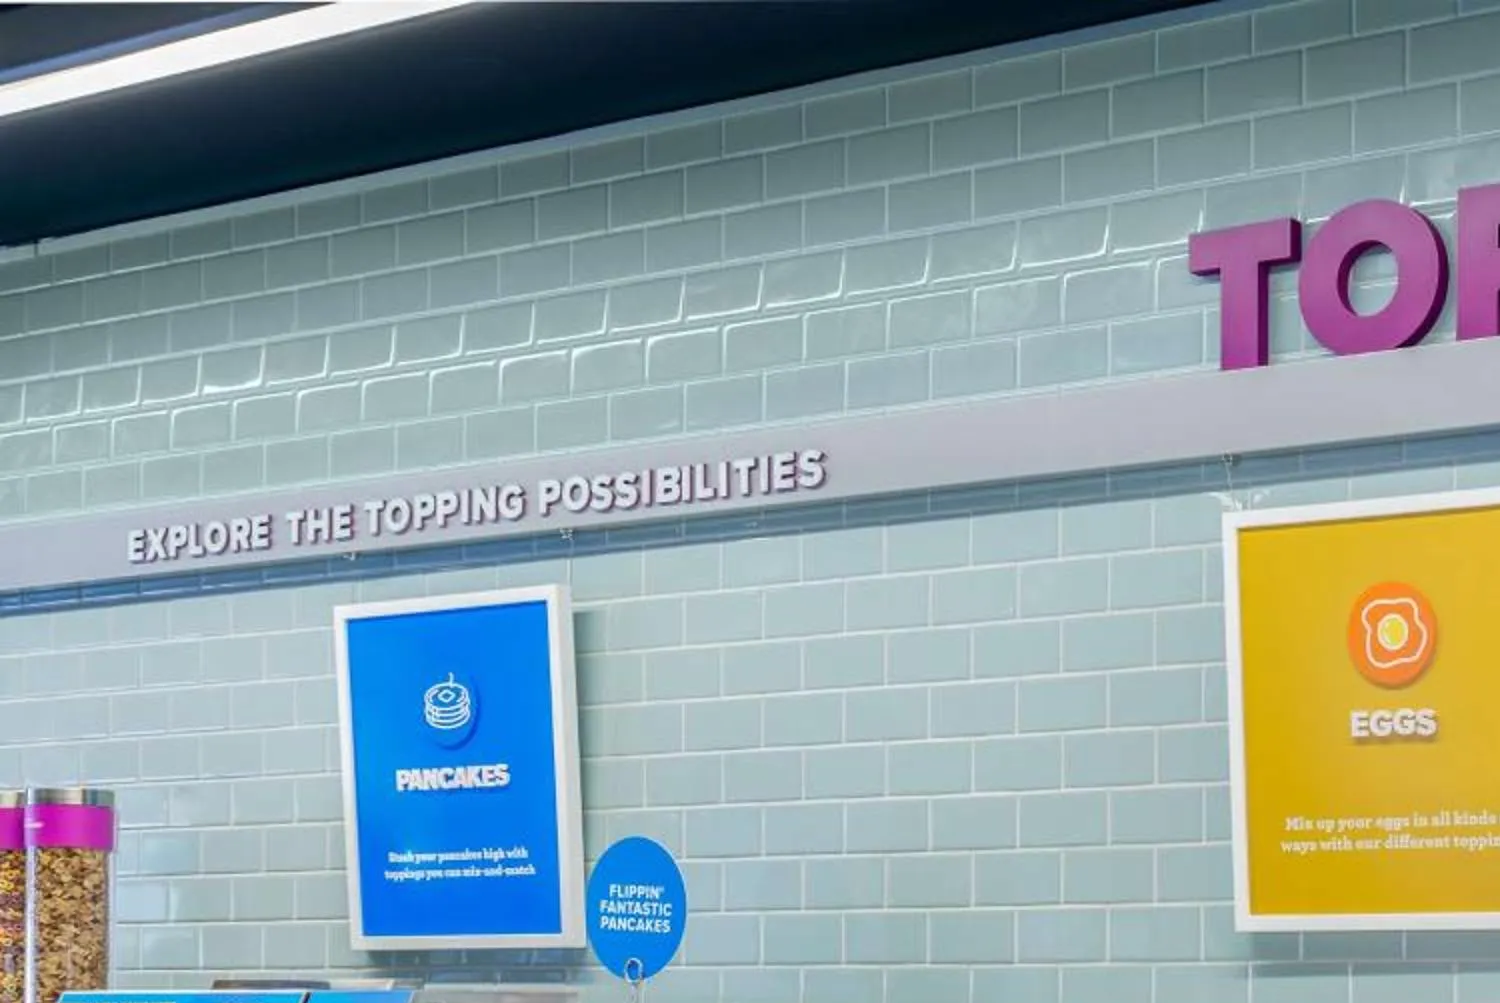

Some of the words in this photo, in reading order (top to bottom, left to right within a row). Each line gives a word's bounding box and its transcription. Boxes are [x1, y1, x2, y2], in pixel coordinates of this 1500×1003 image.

[127, 513, 273, 564] EXPLORE
[287, 503, 354, 546] THE
[364, 486, 526, 536] TOPPING
[539, 448, 827, 516] POSSIBILITIES
[1350, 707, 1437, 737] EGGS
[395, 763, 511, 792] PANCAKES
[1316, 818, 1334, 832] up
[1338, 817, 1373, 833] your
[1375, 816, 1409, 832] eggs
[1413, 811, 1428, 827] in
[1431, 810, 1450, 826] all
[1453, 809, 1498, 826] kinds
[1280, 840, 1317, 856] ways
[1319, 836, 1354, 851] with
[1355, 838, 1382, 850] our
[1384, 833, 1450, 850] different
[600, 899, 673, 917] FANTASTIC
[600, 915, 672, 933] PANCAKES
